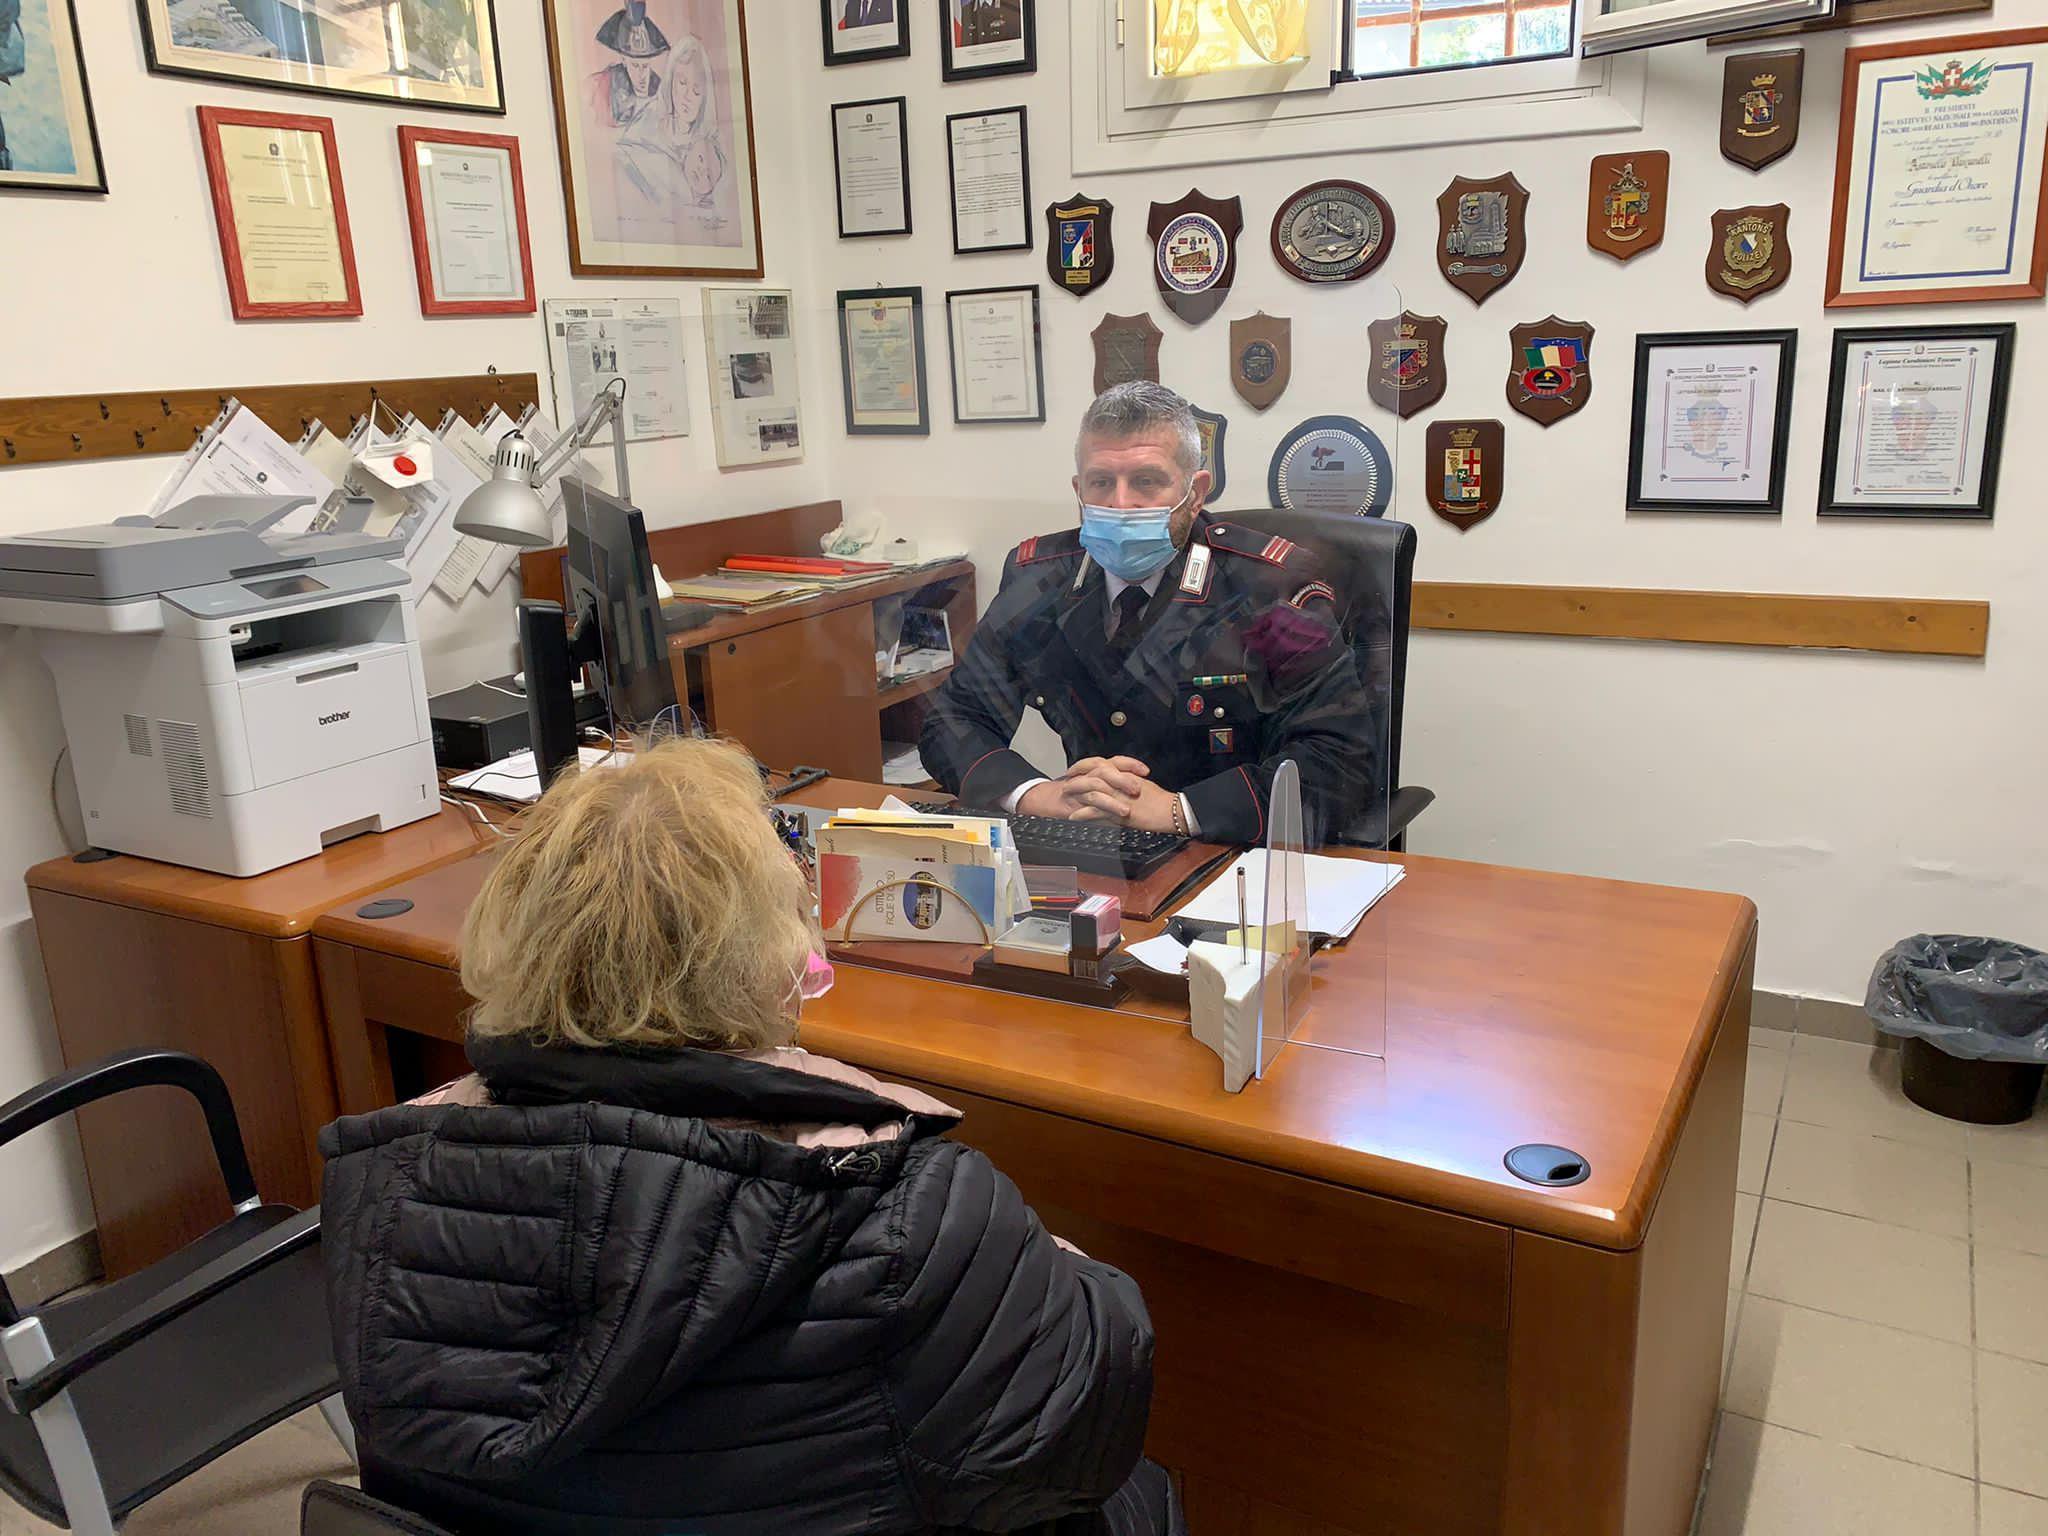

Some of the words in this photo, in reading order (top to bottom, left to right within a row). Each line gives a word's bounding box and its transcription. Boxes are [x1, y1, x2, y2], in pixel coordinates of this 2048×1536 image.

[1730, 223, 1769, 236] KANTONS
[1732, 251, 1763, 262] POLIZEI
[318, 710, 351, 726] brother
